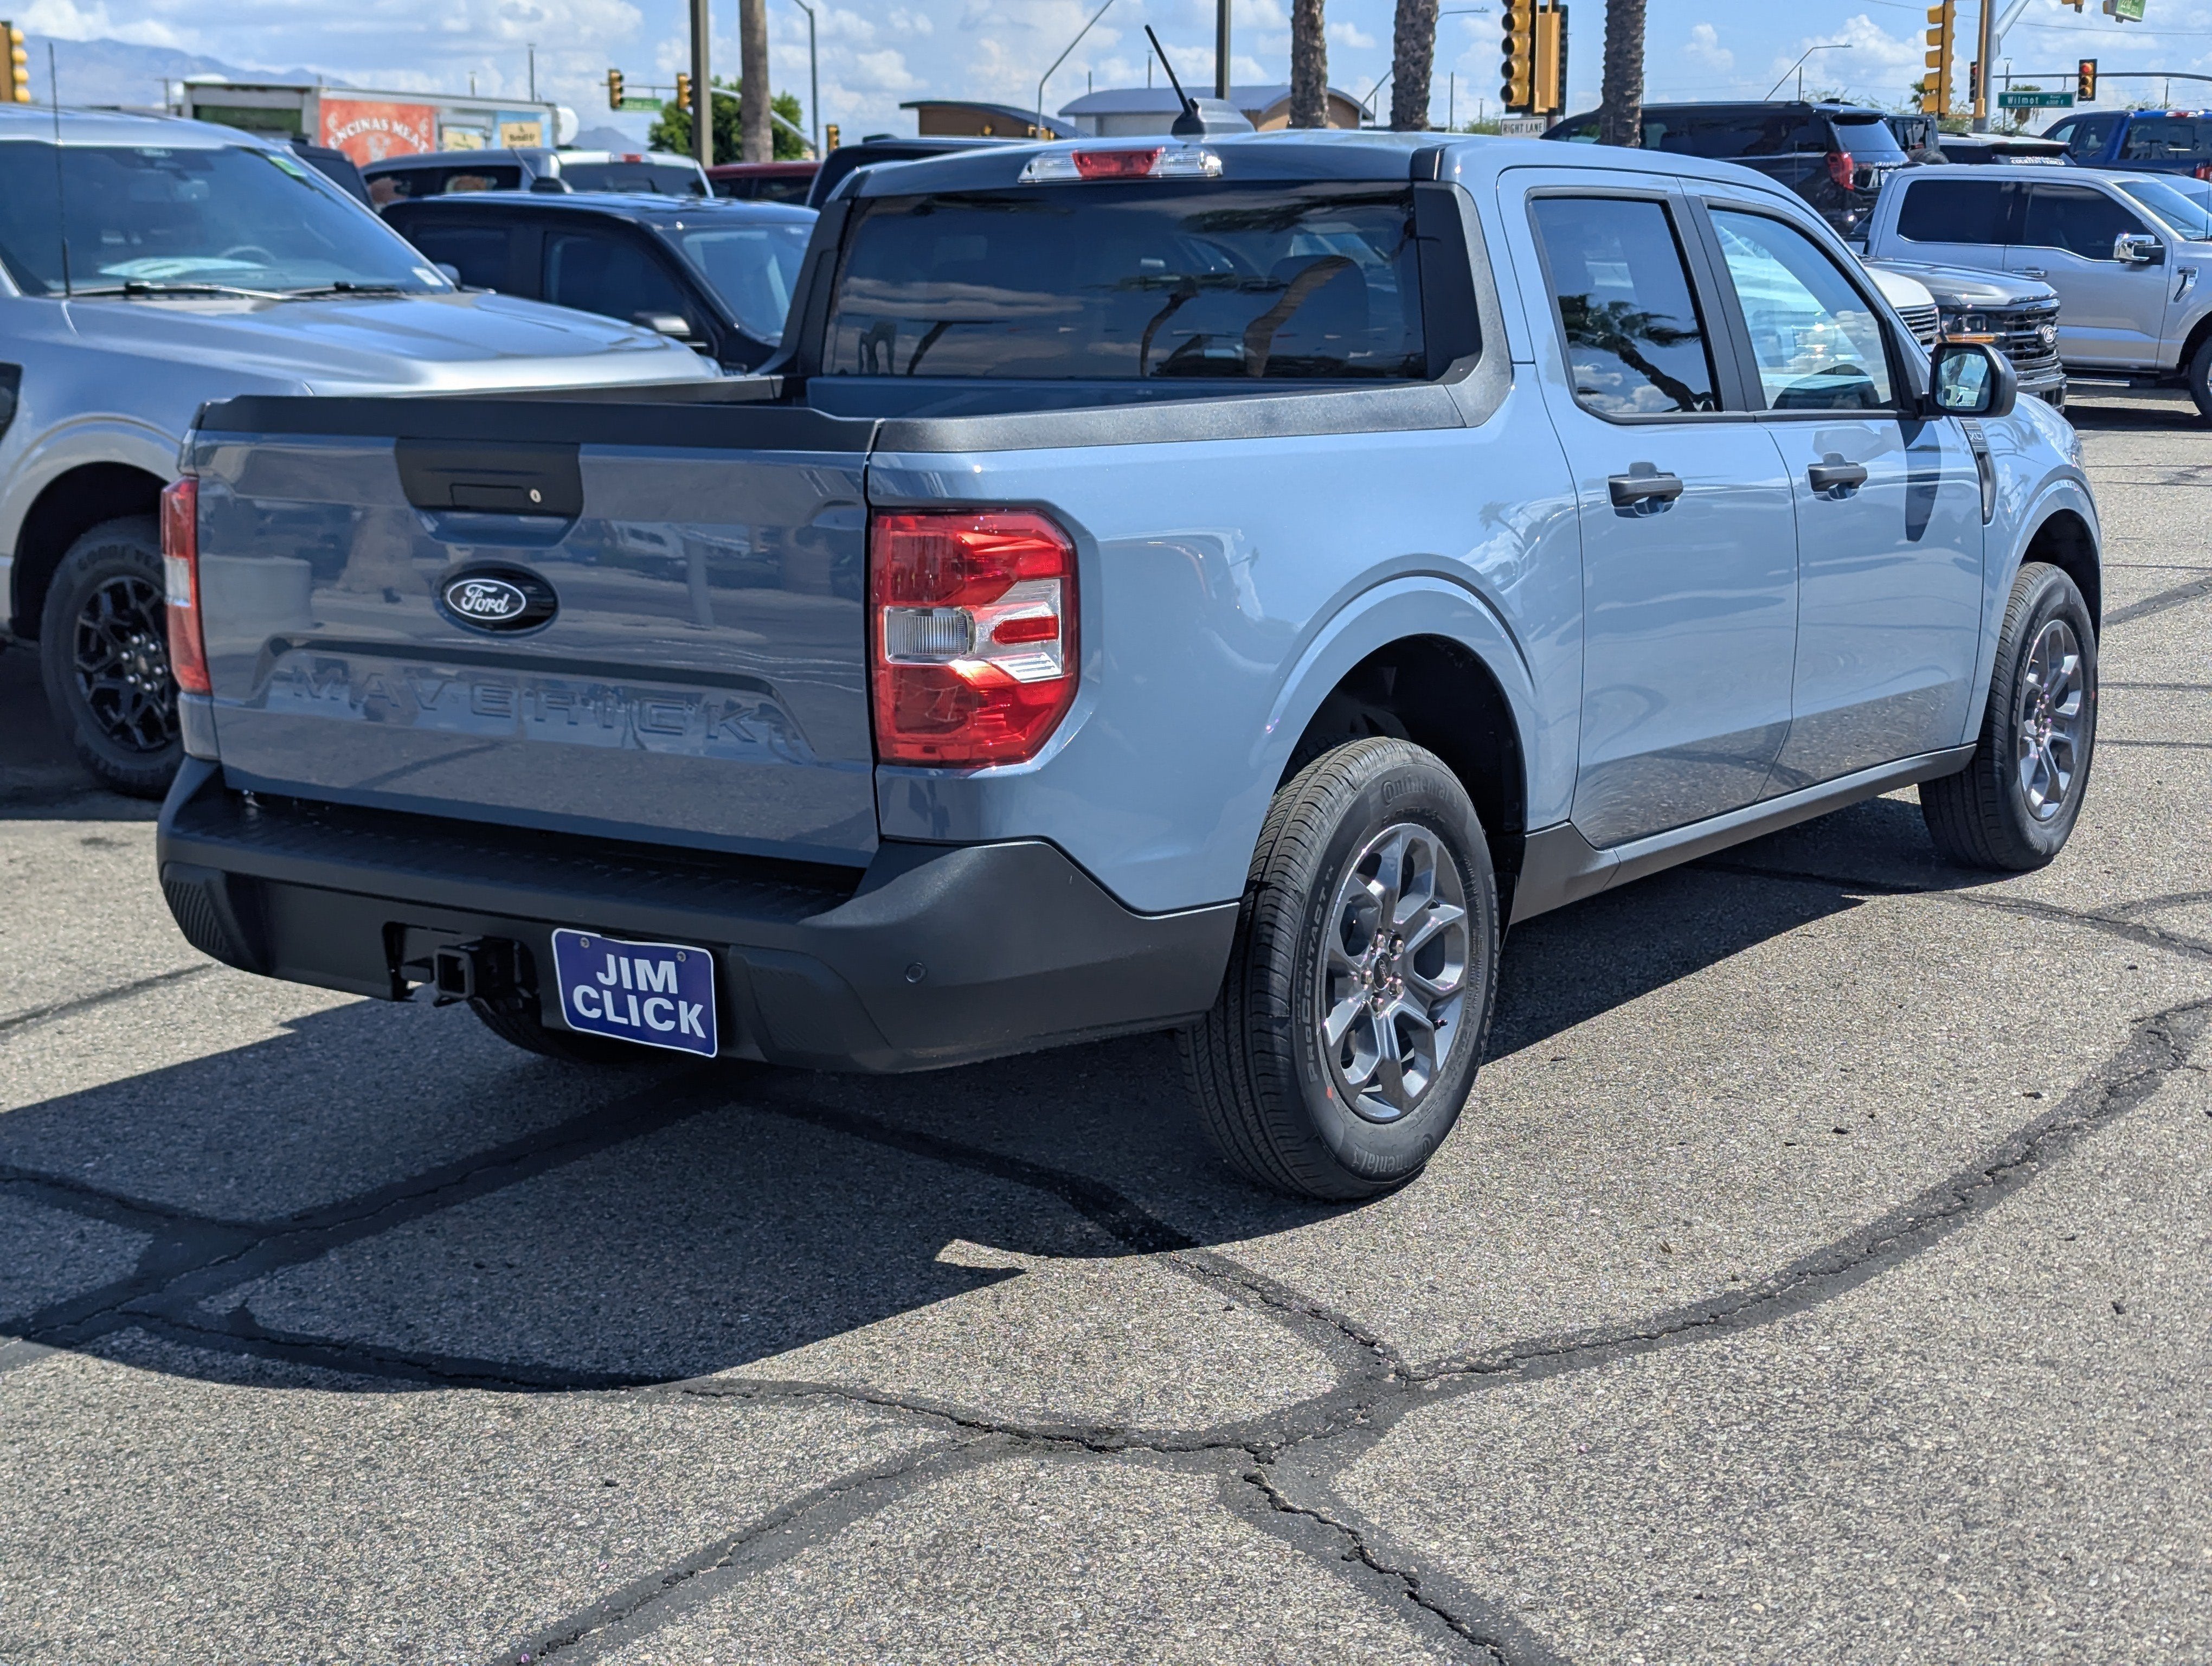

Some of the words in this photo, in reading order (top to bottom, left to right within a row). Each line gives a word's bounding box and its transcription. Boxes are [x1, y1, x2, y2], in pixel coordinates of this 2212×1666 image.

[2007, 96, 2039, 105] Wilmot
[328, 118, 389, 150] ENCINAS
[1503, 123, 1523, 134] RIGHT
[1526, 123, 1543, 133] LANE
[461, 584, 510, 614] Ford
[292, 666, 757, 743] MAVERICK
[1382, 774, 1450, 807] Continental
[596, 953, 678, 995] JIM
[573, 984, 707, 1039] CLICK
